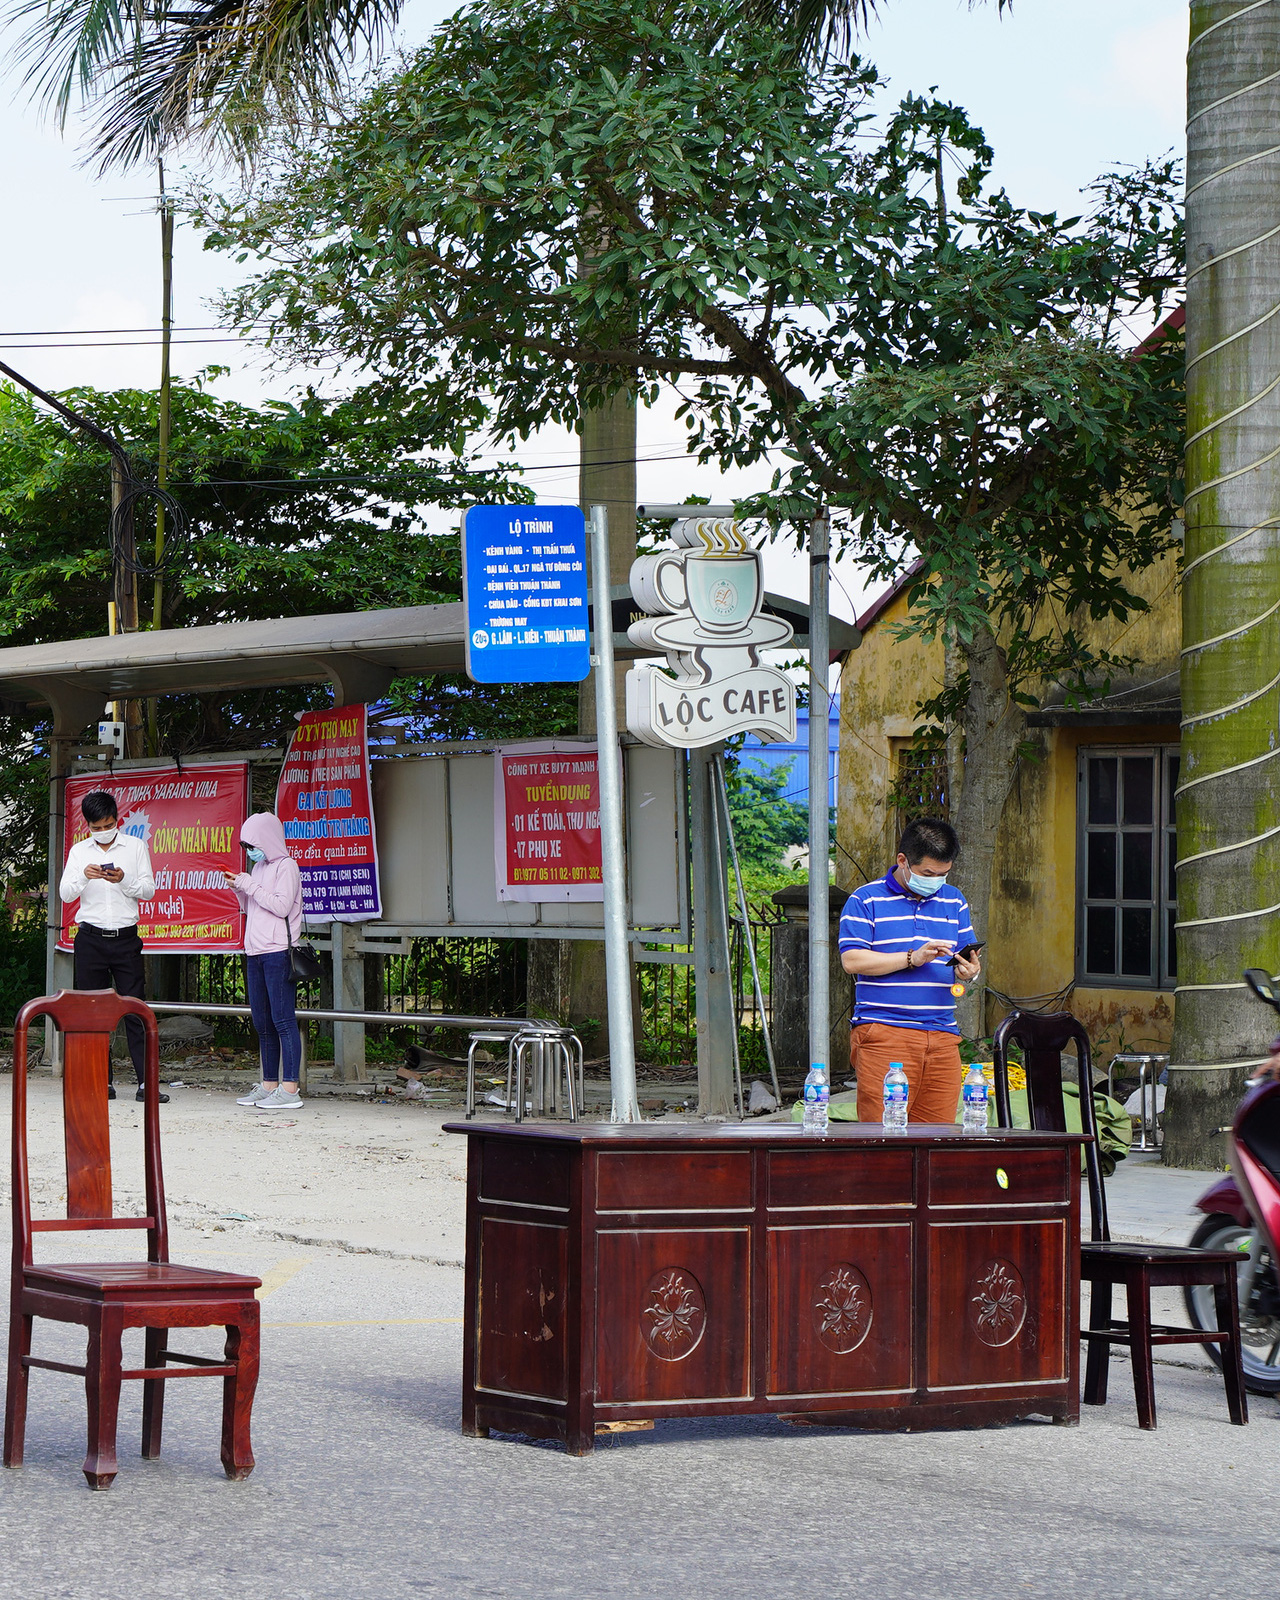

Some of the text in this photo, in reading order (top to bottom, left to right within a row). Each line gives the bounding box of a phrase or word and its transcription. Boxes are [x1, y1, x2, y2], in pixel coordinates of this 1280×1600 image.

[508, 517, 554, 538] LỘ TRÌNH
[505, 544, 523, 556] VÀNG
[532, 545, 542, 557] THỊ
[658, 687, 787, 732] LỘC CAFE
[339, 717, 359, 738] MAY
[350, 745, 361, 757] CAO
[283, 767, 310, 783] LƯƠNG
[507, 762, 527, 776] CÔNG
[529, 763, 538, 775] TY
[540, 762, 550, 774] XE
[194, 780, 219, 798] VINA
[527, 808, 540, 831] KẾ
[566, 811, 584, 830] THU
[153, 819, 179, 854] CÔNG
[179, 818, 208, 854] NHÂN
[209, 826, 234, 853] MAY
[347, 842, 367, 857] năm
[528, 840, 548, 862] PHỤ
[550, 839, 562, 857] XE
[312, 871, 328, 882] 370
[550, 867, 558, 880] 11
